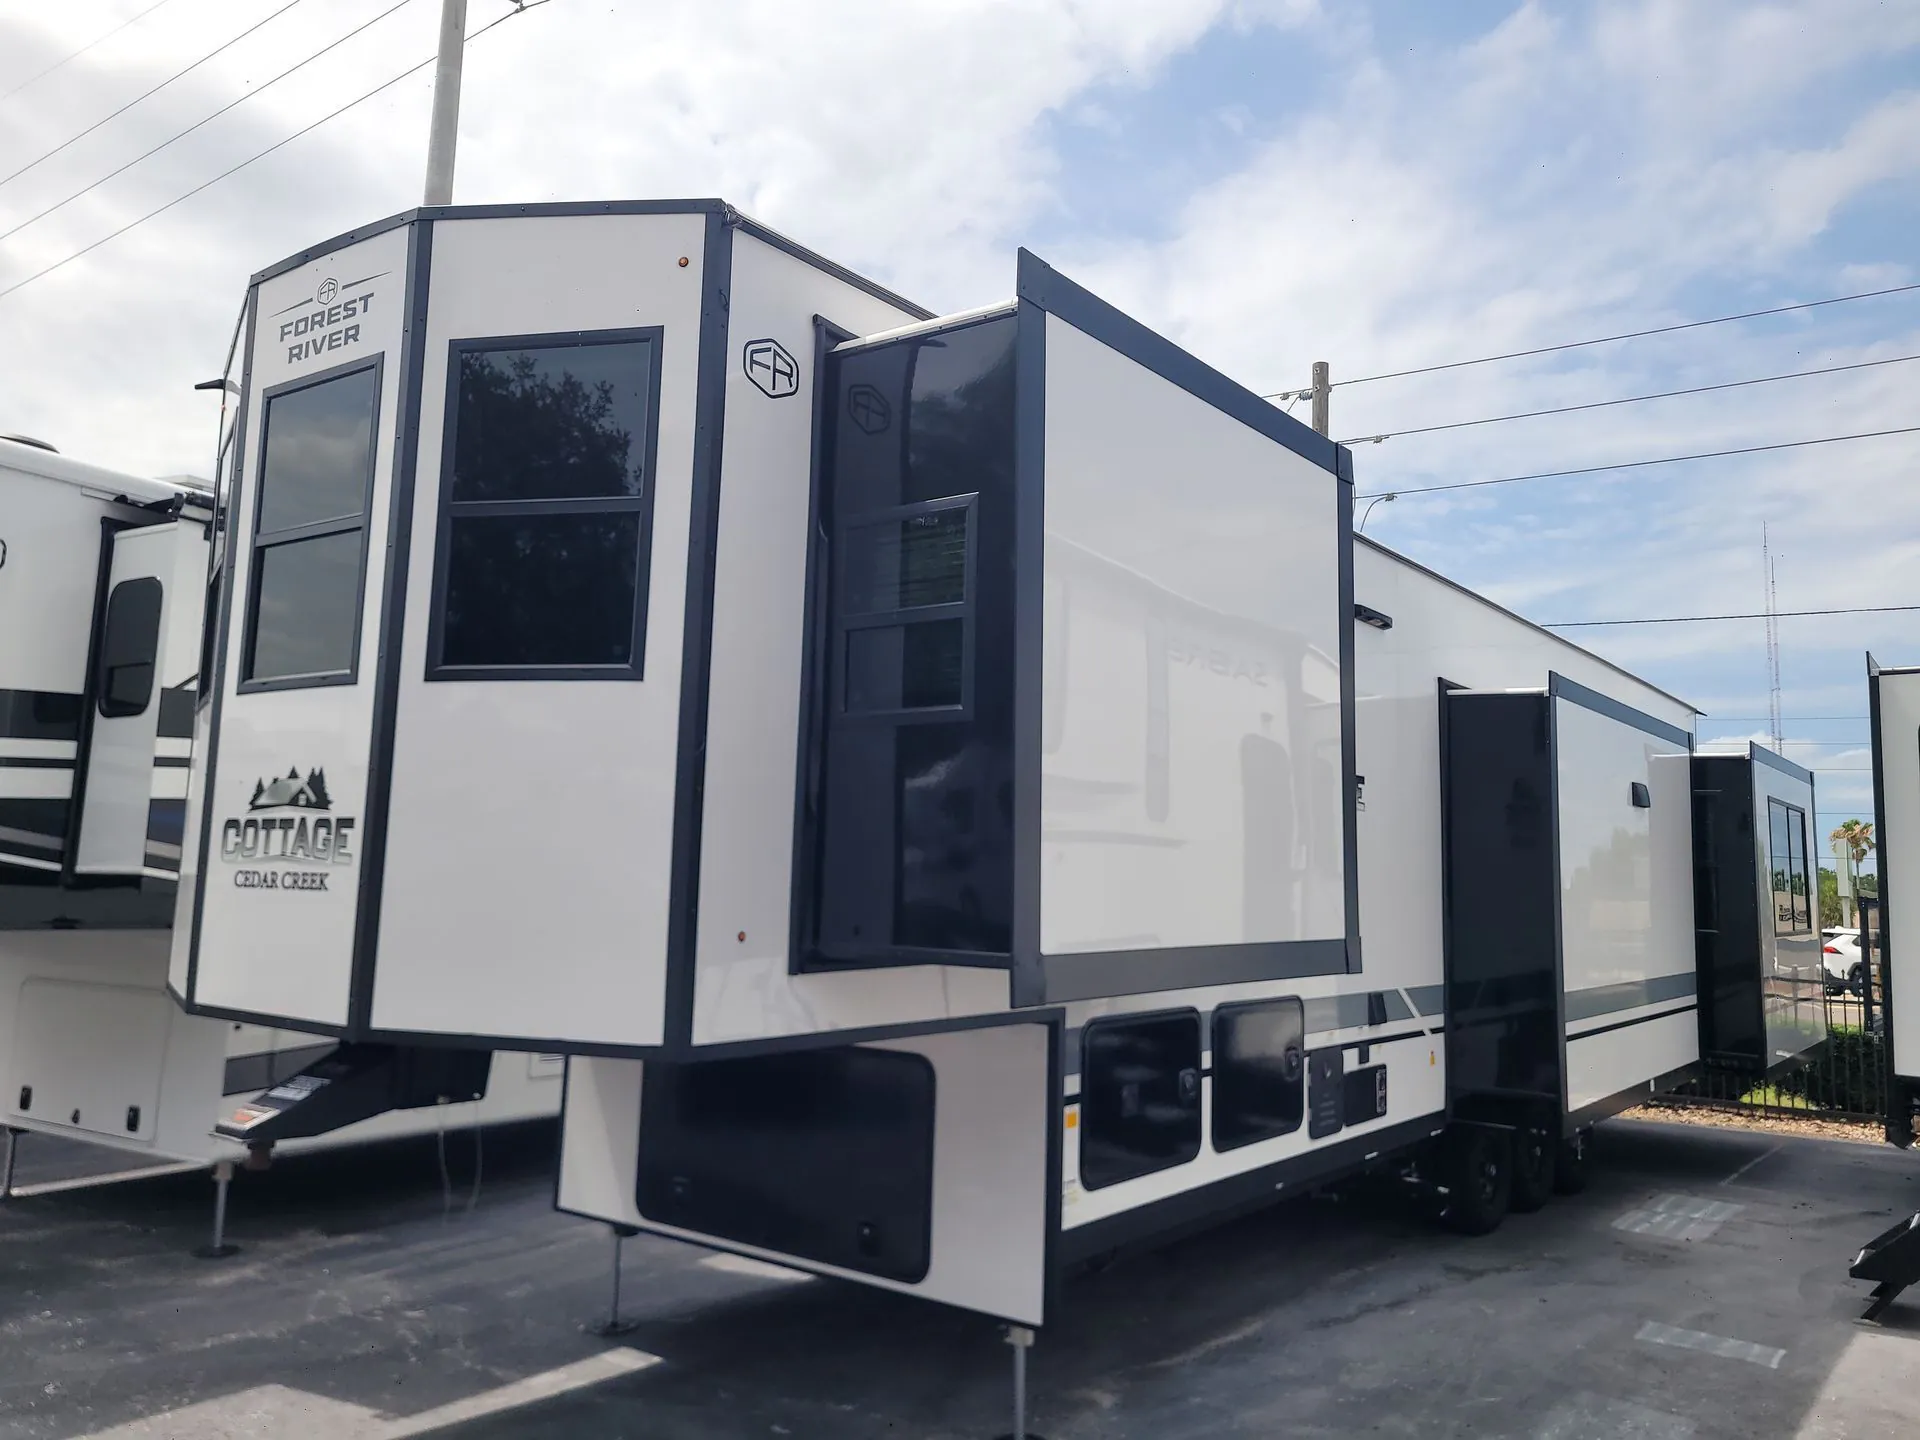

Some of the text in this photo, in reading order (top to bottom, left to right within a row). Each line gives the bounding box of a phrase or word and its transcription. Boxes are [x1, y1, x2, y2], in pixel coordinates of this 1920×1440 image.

[279, 292, 375, 342] FOREST
[287, 323, 361, 365] RIVER
[222, 817, 356, 864] COTTAGE
[234, 869, 330, 891] CEDAR CREEK
